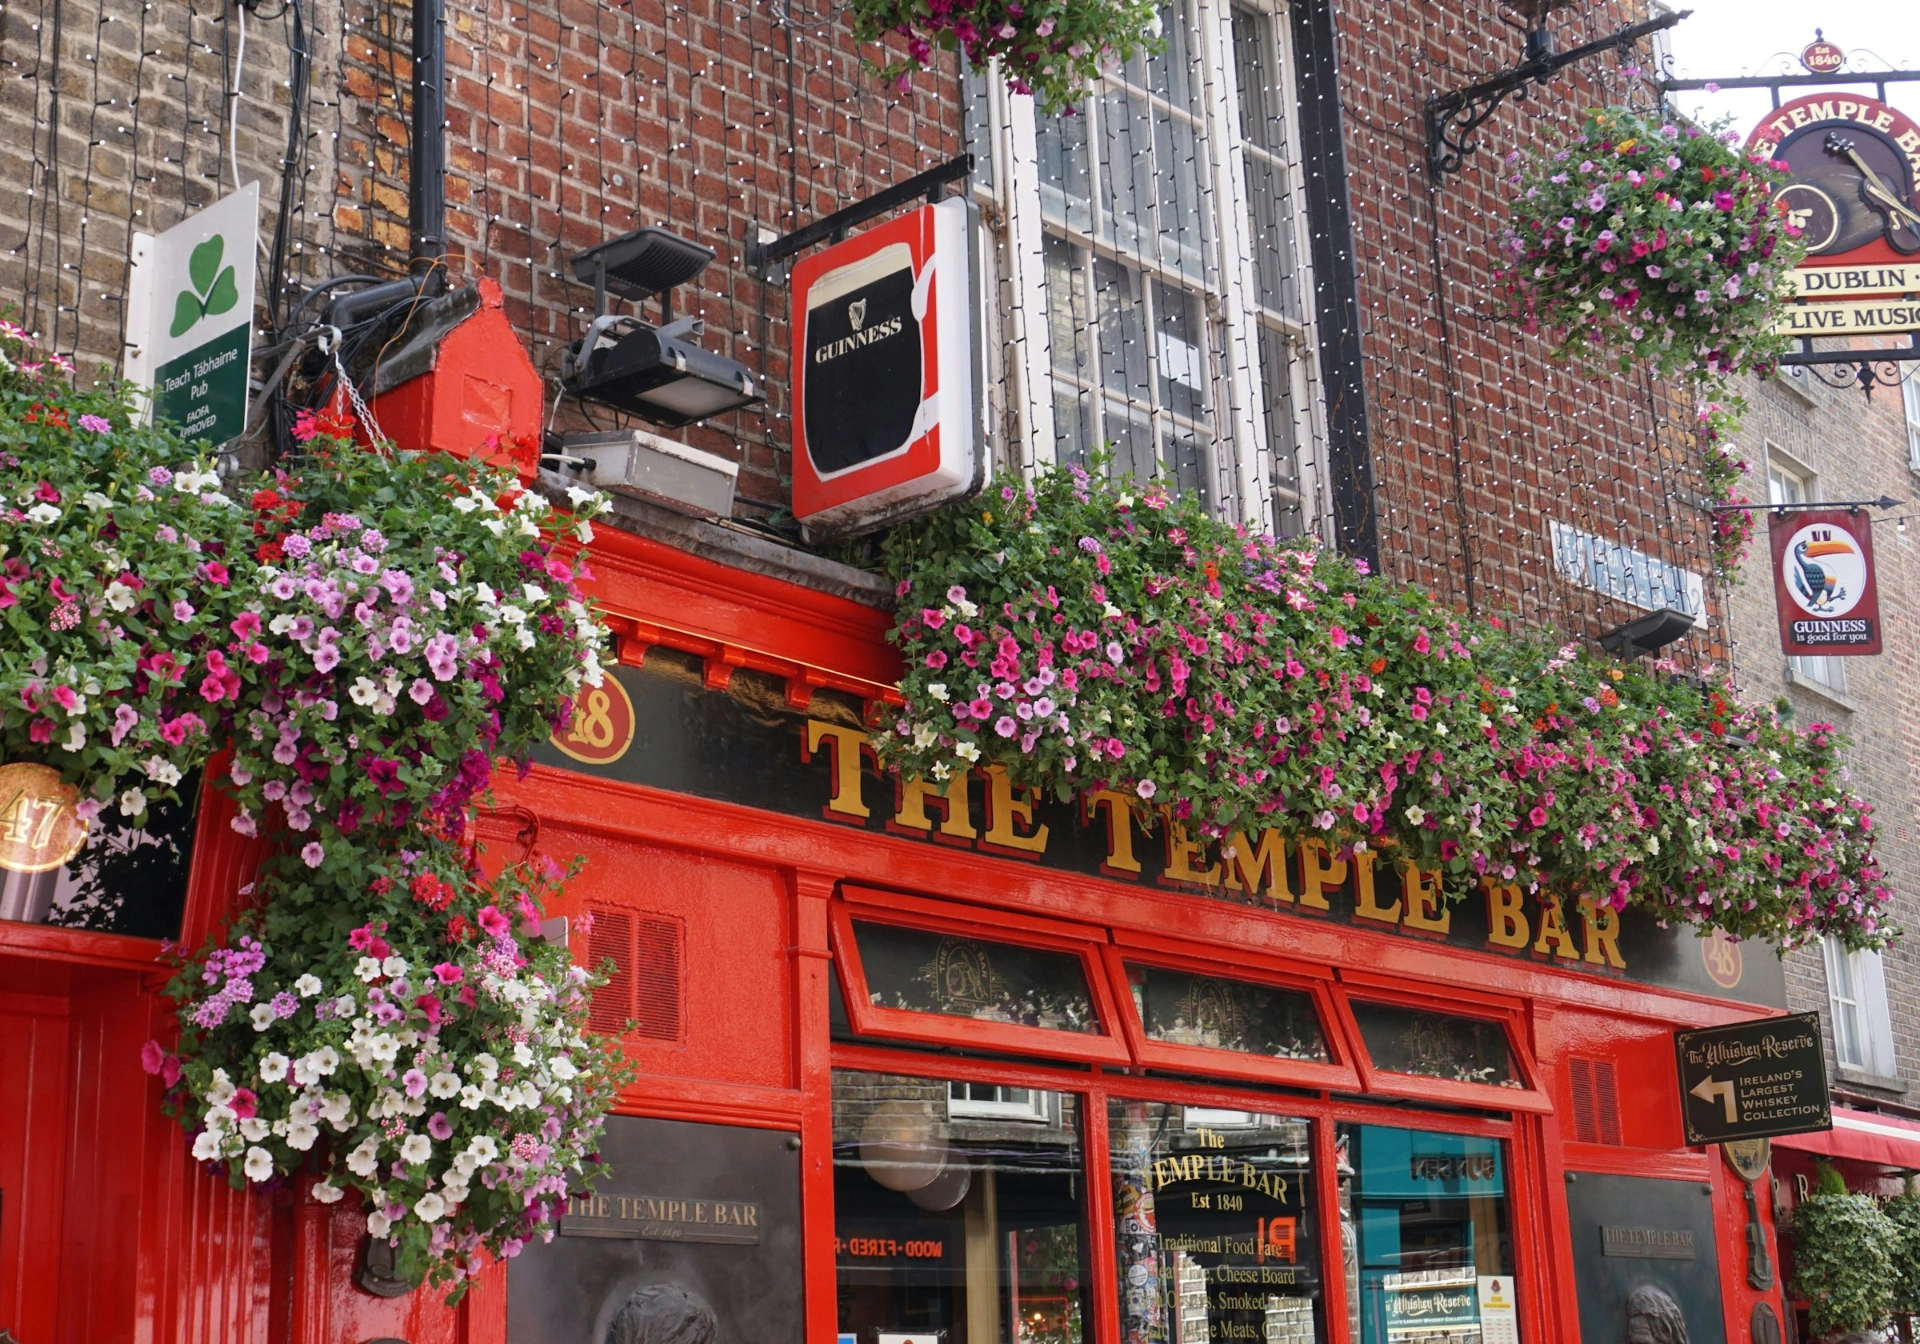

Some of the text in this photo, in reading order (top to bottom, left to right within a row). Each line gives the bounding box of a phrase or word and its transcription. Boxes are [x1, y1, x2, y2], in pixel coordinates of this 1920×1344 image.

[1808, 54, 1841, 66] 1840
[1814, 46, 1830, 54] Est
[1770, 100, 1895, 138] TEMPLE
[1804, 269, 1906, 291] DUBLIN
[1790, 310, 1846, 329] LIVE
[815, 316, 902, 364] GUINNESS
[165, 369, 191, 393] Teach
[191, 380, 208, 400] Pub
[186, 404, 210, 424] FAOFA
[179, 415, 217, 439] APPROVED
[1794, 620, 1866, 633] GUINNESS
[1796, 632, 1867, 645] is good for you
[804, 719, 1627, 971] THE TEMPLE BAR
[1686, 1034, 1814, 1069] The Whiskey Reserve
[1739, 1069, 1803, 1087] IRELAND'S
[1740, 1083, 1795, 1099] LARGEST
[1742, 1095, 1798, 1110] WHISKEY
[1743, 1103, 1820, 1122] COLLECTION
[1197, 1128, 1225, 1149] The
[1242, 1162, 1288, 1205] BAR
[565, 1196, 758, 1227] THE TEMPLE BAR
[1191, 1192, 1243, 1211] Est 1840
[1157, 1232, 1282, 1256] Traditional Food Fare
[1216, 1264, 1259, 1283] Cheese
[1261, 1266, 1296, 1285] Board
[1218, 1291, 1265, 1311] Smoked
[1434, 1291, 1471, 1315] Reserve
[1220, 1320, 1259, 1340] Meats,
